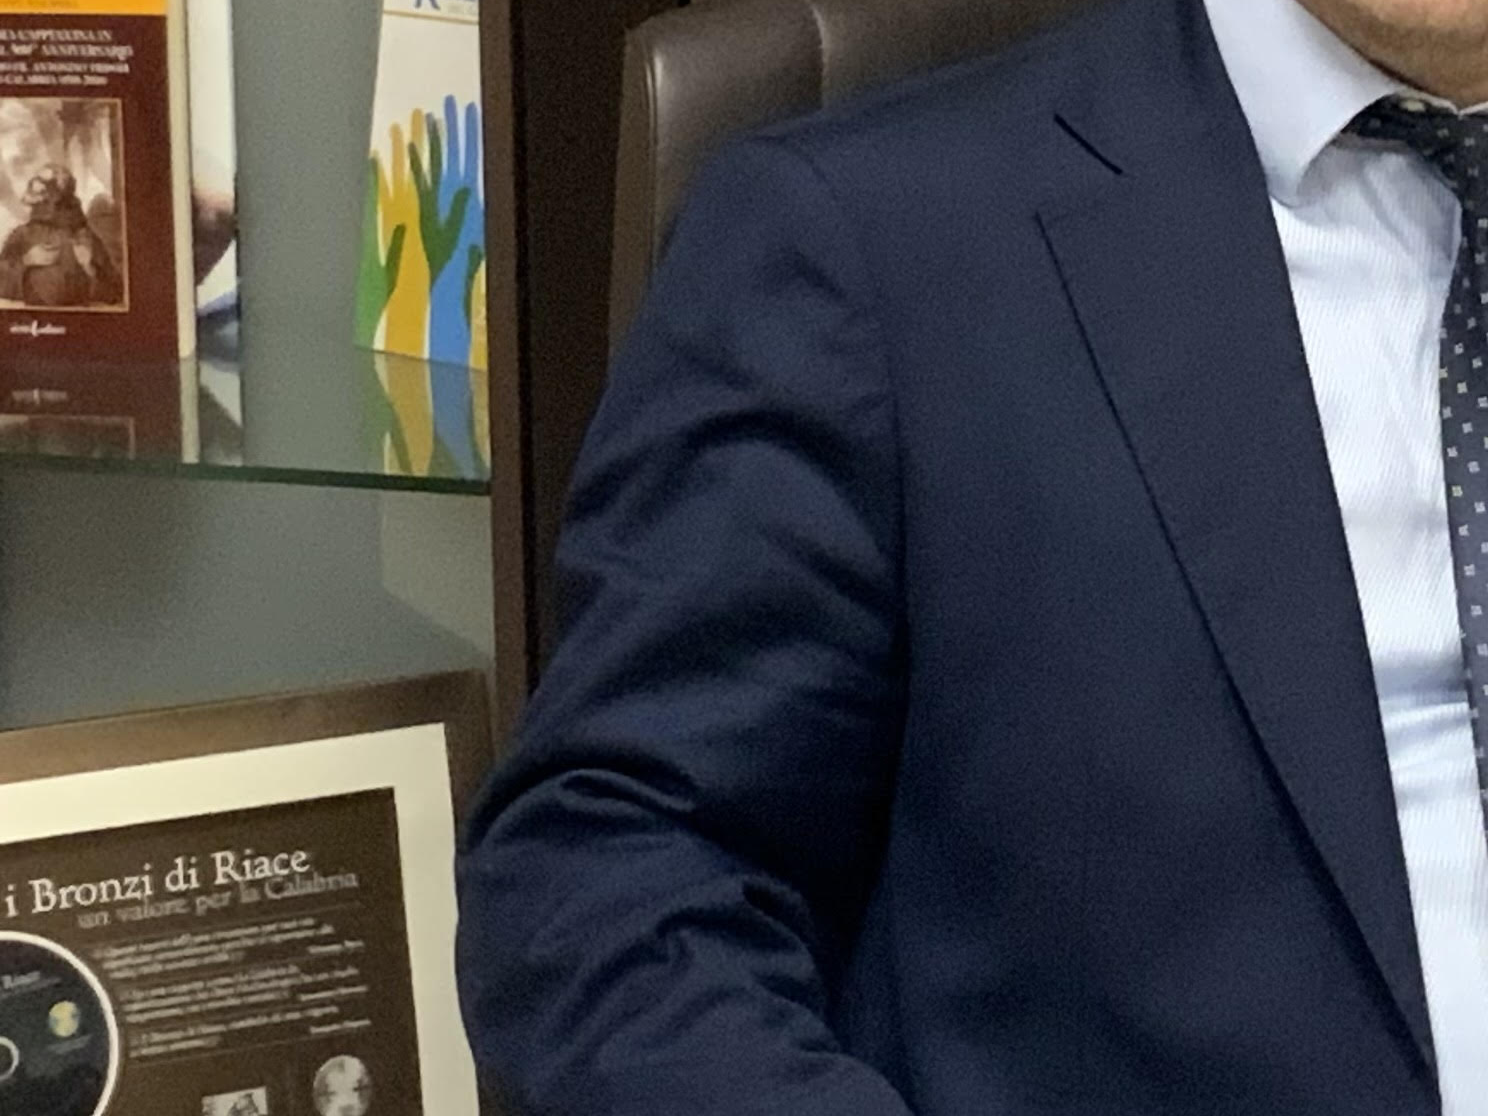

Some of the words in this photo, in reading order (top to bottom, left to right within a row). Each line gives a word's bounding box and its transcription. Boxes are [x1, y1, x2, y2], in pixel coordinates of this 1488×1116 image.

[5, 885, 18, 917] i
[28, 862, 153, 914] Bronzi
[164, 856, 199, 893] di
[210, 848, 311, 886] Riace
[264, 871, 358, 900] Calabria
